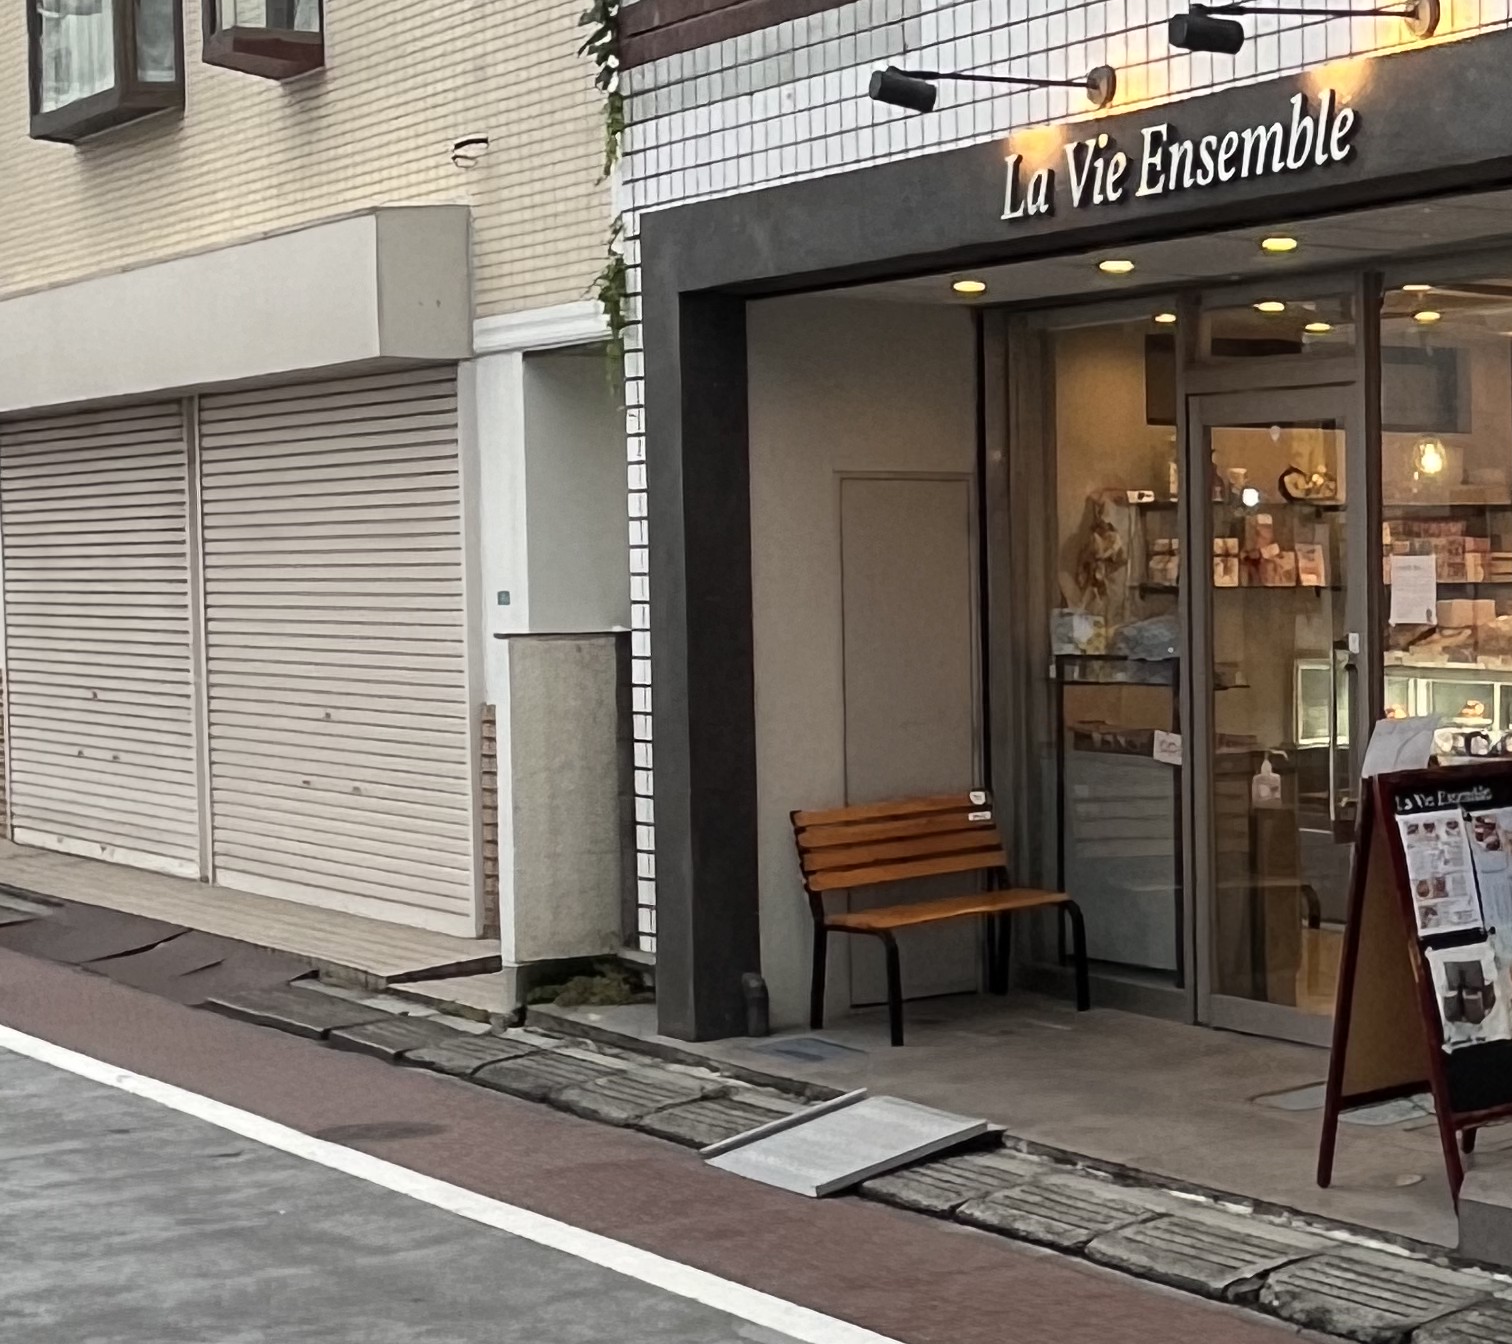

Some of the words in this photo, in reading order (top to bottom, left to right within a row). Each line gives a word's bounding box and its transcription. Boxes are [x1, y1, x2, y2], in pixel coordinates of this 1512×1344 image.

[1000, 154, 1053, 220] La
[1064, 133, 1127, 208] Vie
[1135, 89, 1355, 197] Ensemble
